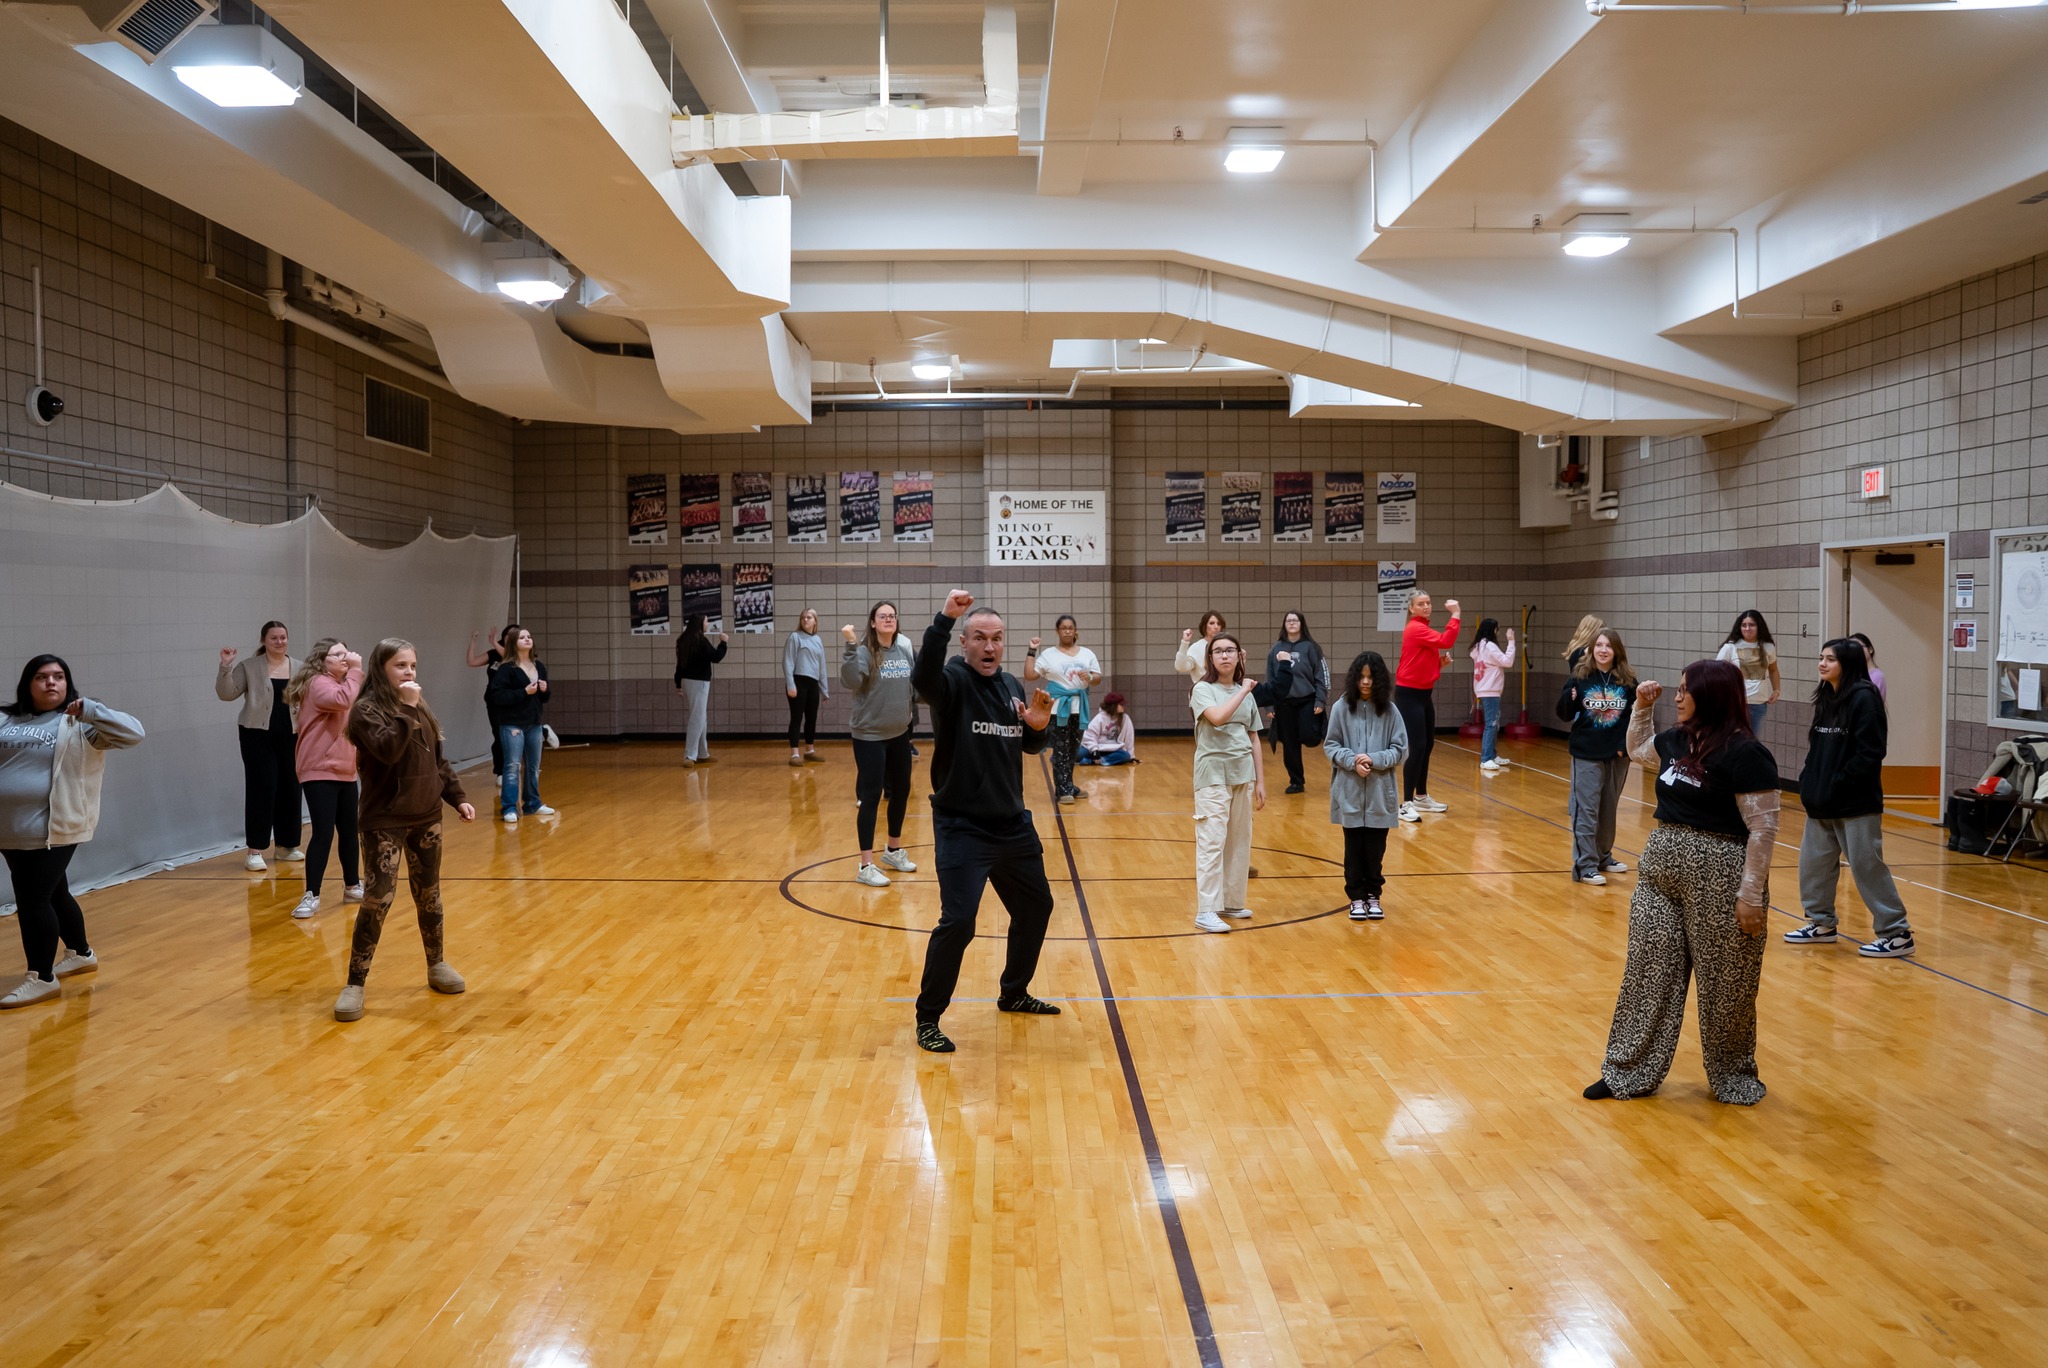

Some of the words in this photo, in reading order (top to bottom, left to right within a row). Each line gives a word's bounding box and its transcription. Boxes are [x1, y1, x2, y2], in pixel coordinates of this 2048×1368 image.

[1865, 471, 1880, 492] EXIT
[1014, 499, 1048, 509] HOME
[1051, 499, 1067, 509] OF
[1071, 499, 1093, 509] THE
[997, 523, 1053, 532] MINOT
[997, 535, 1073, 547] DANCE
[997, 549, 1070, 561] TEAMS
[1583, 697, 1627, 711] Crayola
[22, 726, 57, 749] VALLEY
[0, 741, 42, 750] OSSFIT
